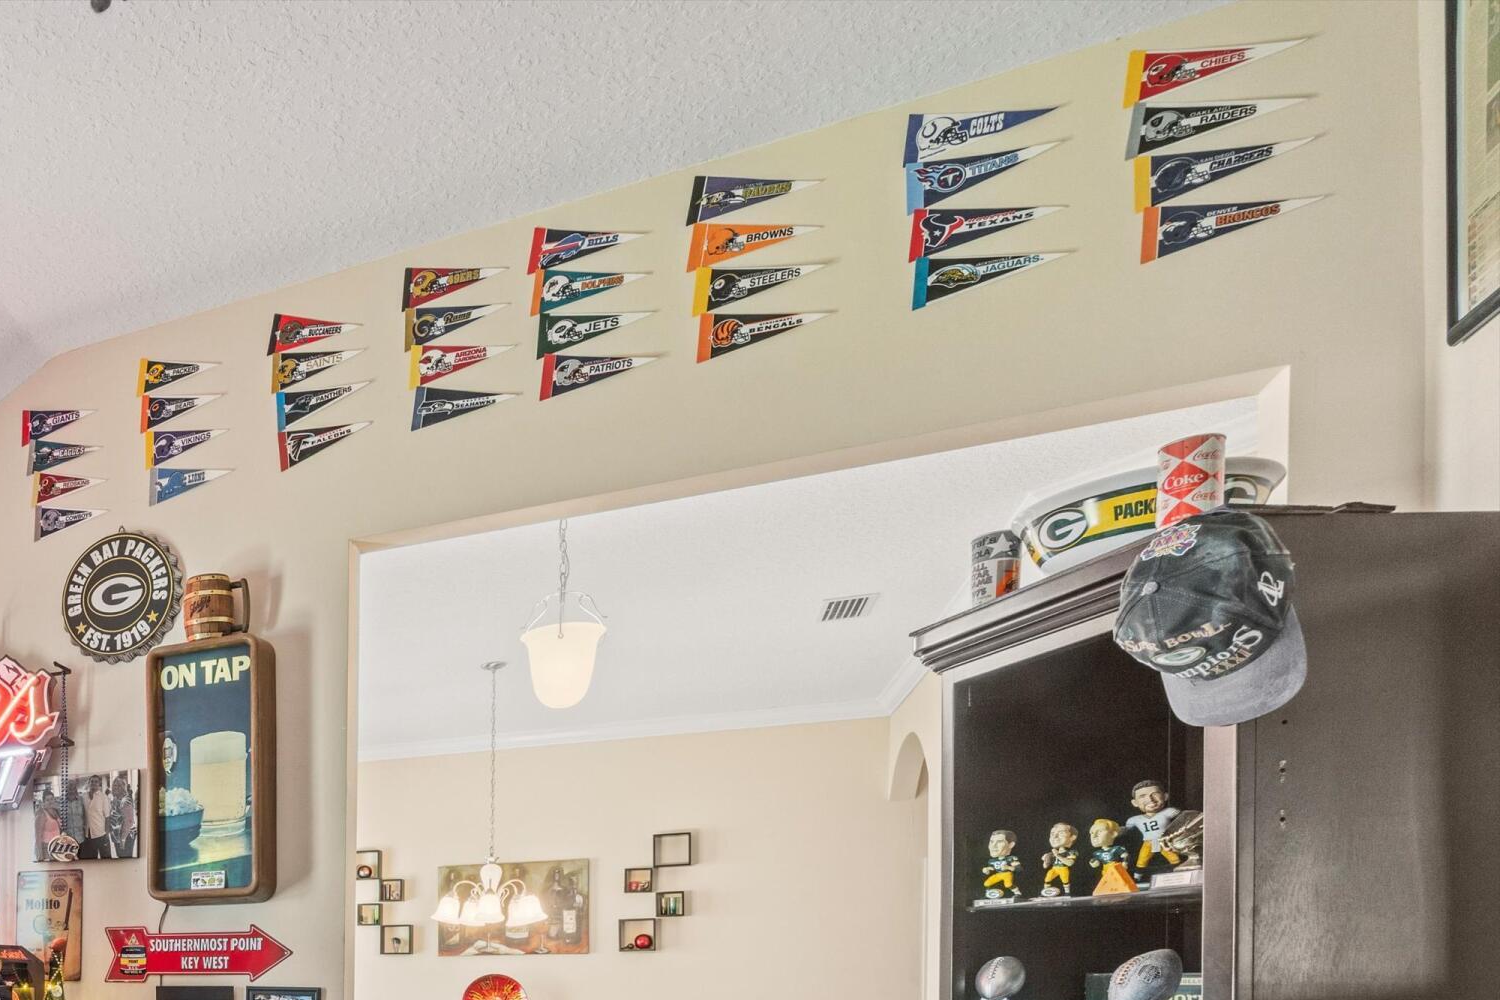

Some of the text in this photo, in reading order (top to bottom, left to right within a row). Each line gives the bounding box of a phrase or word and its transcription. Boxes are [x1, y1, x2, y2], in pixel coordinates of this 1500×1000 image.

[1200, 51, 1245, 69] CHIEFS
[1189, 106, 1231, 117] OAKLAND
[1200, 105, 1257, 124] RAIDERS
[970, 113, 1004, 136] COLTS
[969, 154, 1019, 176] TITANS
[1209, 147, 1273, 171] CHARGERS
[1206, 206, 1238, 217] DENVER
[1215, 203, 1280, 226] BRONCOS
[965, 212, 1035, 228] TEXANS
[587, 233, 620, 247] BILLS
[746, 227, 794, 243] BROWNS
[983, 255, 1041, 274] JAGUARS
[749, 268, 801, 287] STEELERS
[308, 326, 342, 337] BUCCANEERS
[584, 317, 620, 333] JETS
[749, 319, 803, 333] BENGALS
[306, 353, 343, 370] SAINTS
[454, 353, 487, 364] CARDINALS
[588, 358, 633, 374] PATRIOTS
[172, 364, 200, 376] PACKERS
[315, 386, 352, 403] PANTHERS
[174, 401, 195, 410] BEARS
[455, 399, 496, 409] SEAHAWKS
[52, 412, 80, 425] GIANTS
[181, 432, 211, 446] VIKINGS
[311, 428, 352, 445] FALCONS
[1164, 474, 1204, 490] Coke
[66, 512, 92, 521] COWBOYS
[67, 539, 168, 618] GREEN BAY PACKERS
[81, 620, 151, 651] EST. 1919
[161, 655, 251, 691] ON TAP
[1142, 820, 1160, 833] 12
[26, 898, 60, 911] Mojito
[149, 937, 263, 952] SOUTHERNMOST POINT
[181, 956, 230, 970] KEY WEST
